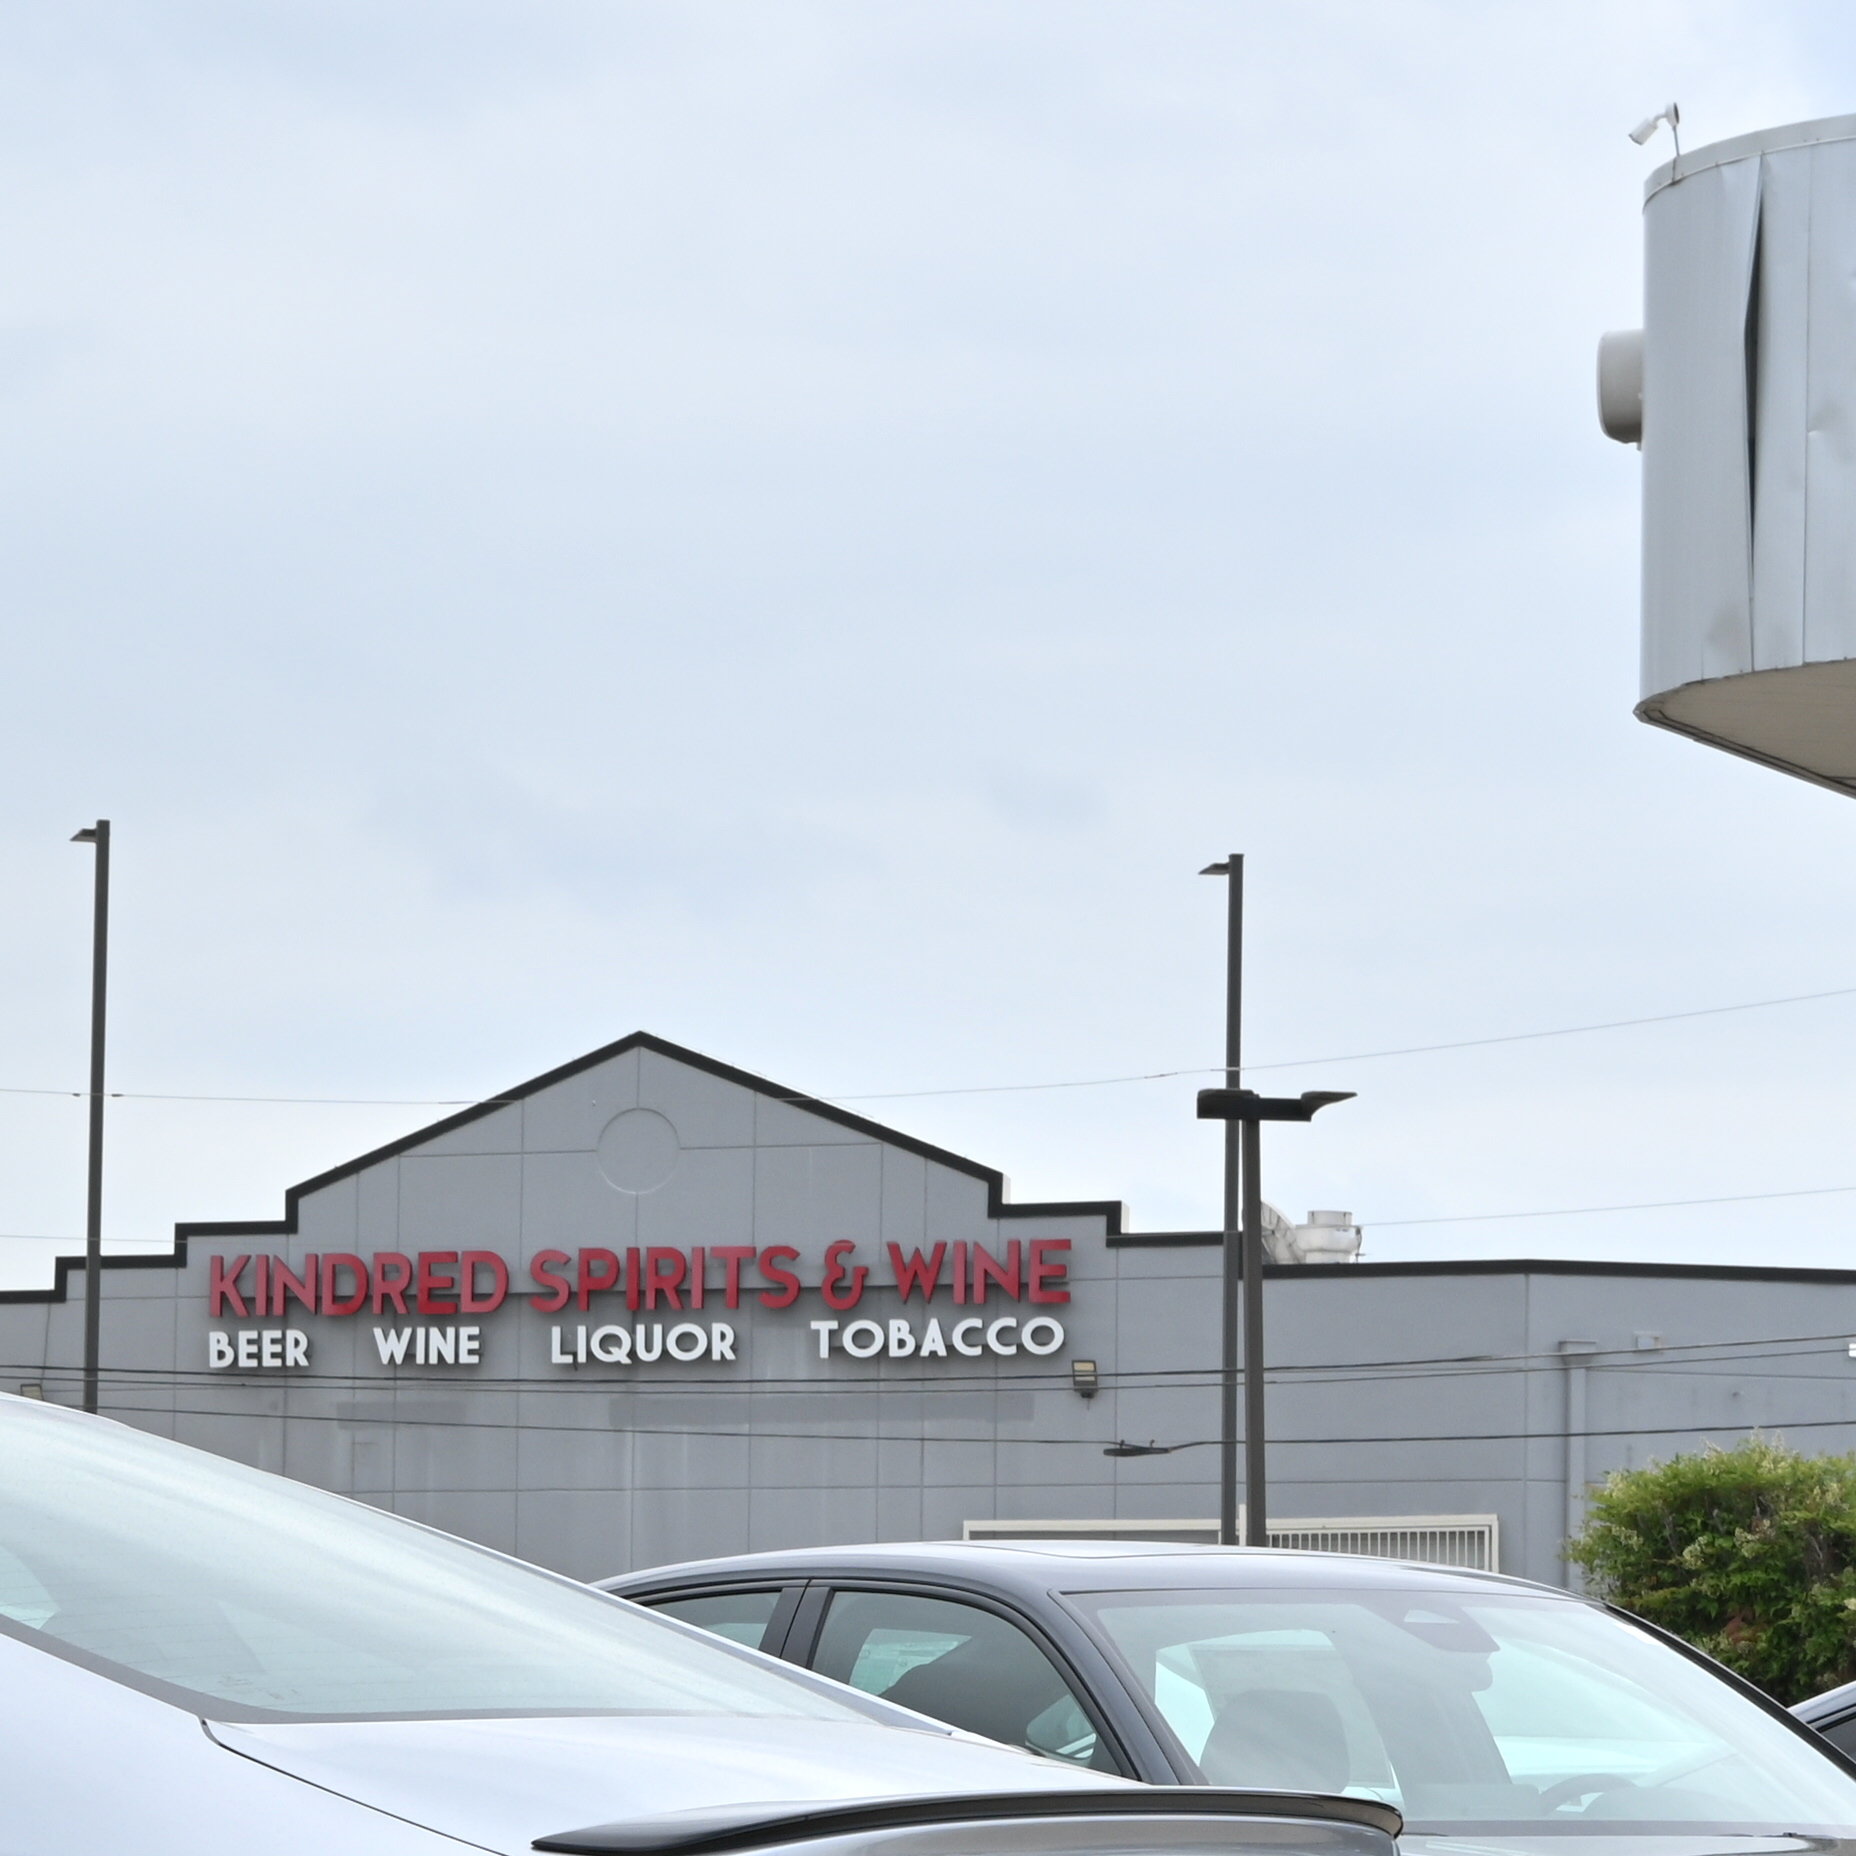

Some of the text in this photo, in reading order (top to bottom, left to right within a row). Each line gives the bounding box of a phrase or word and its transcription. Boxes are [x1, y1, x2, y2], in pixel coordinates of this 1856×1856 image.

[209, 1239, 1072, 1318] KINDRED SPIRITS & WINE
[208, 1316, 1065, 1368] BEER WINE LIQUOR TOBACCO
